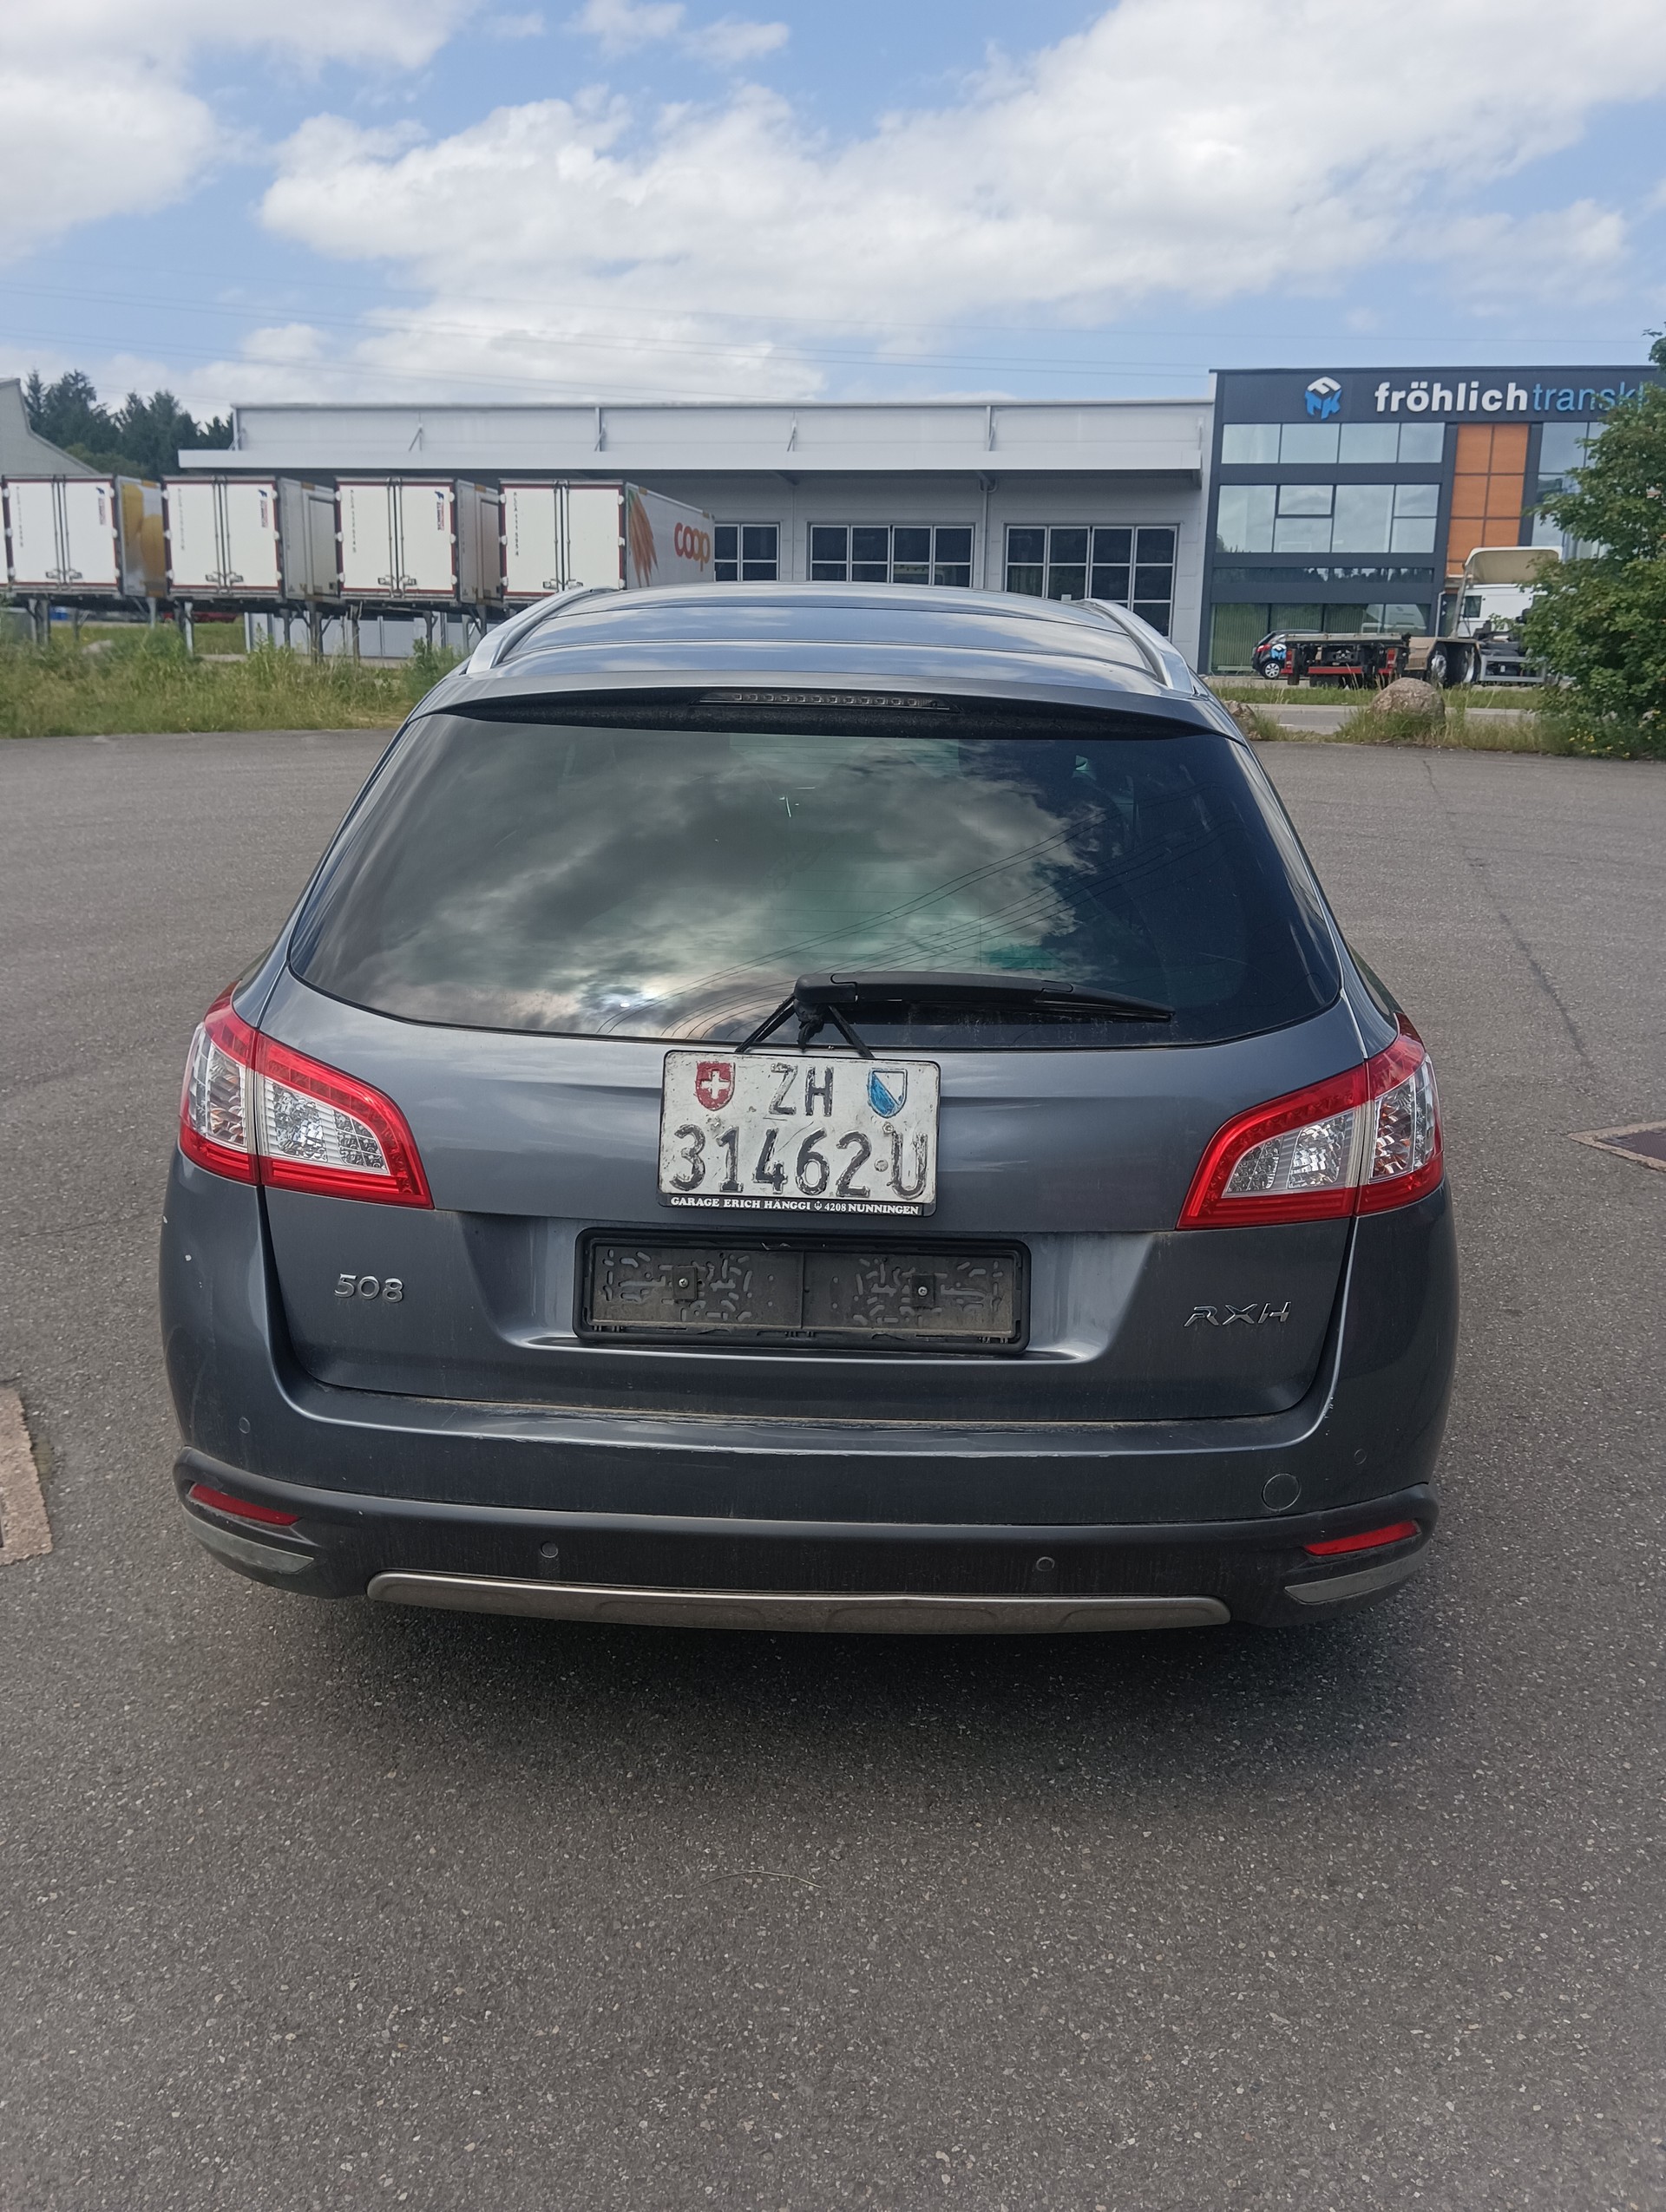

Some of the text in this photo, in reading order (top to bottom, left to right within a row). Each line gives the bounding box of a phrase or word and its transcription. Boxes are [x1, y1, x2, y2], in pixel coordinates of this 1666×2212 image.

[674, 521, 711, 573] coop
[768, 1061, 835, 1117] ZH
[670, 1196, 919, 1215] GARAGE ERICH HÄNGGI 4208 NUNNINGEN
[334, 1273, 403, 1303] 508
[1184, 1301, 1291, 1327] RXH
